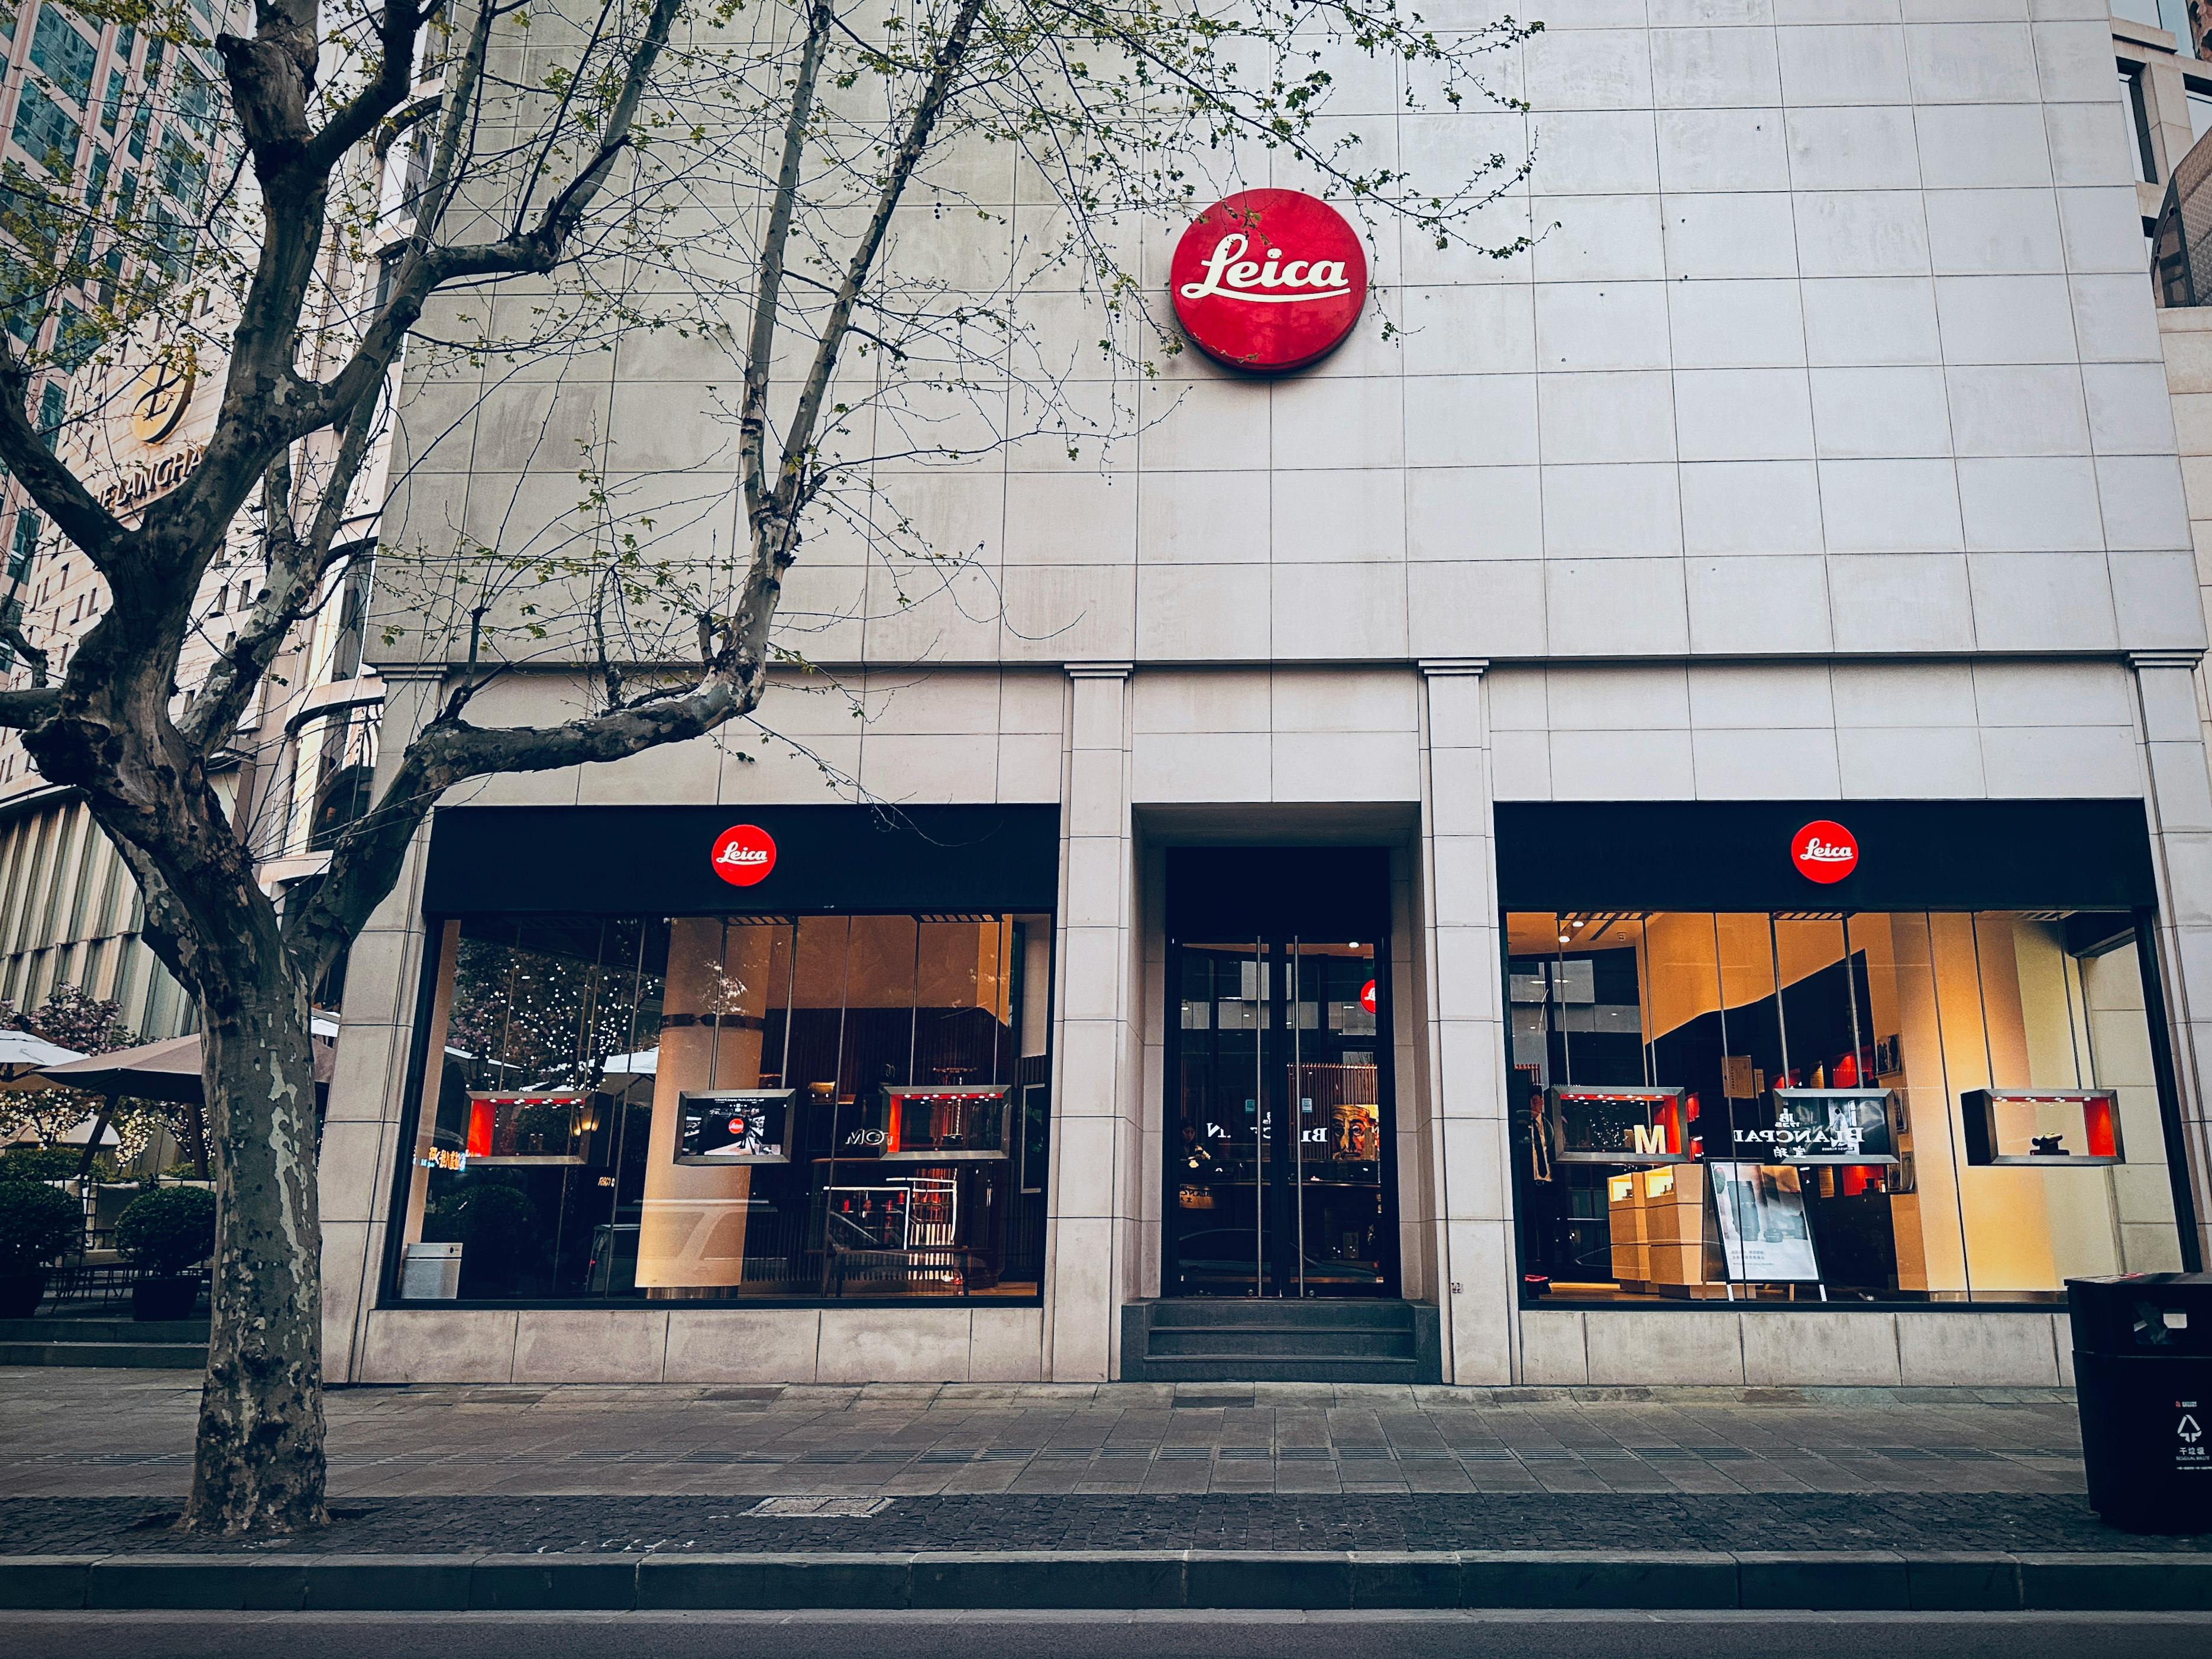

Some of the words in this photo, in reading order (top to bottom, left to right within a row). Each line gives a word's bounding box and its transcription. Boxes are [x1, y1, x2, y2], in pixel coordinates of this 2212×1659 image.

[1181, 233, 1351, 303] Leica
[115, 448, 203, 506] LANGHA
[716, 841, 768, 865] Leica
[1800, 837, 1854, 862] Leica
[1634, 1124, 1666, 1154] M
